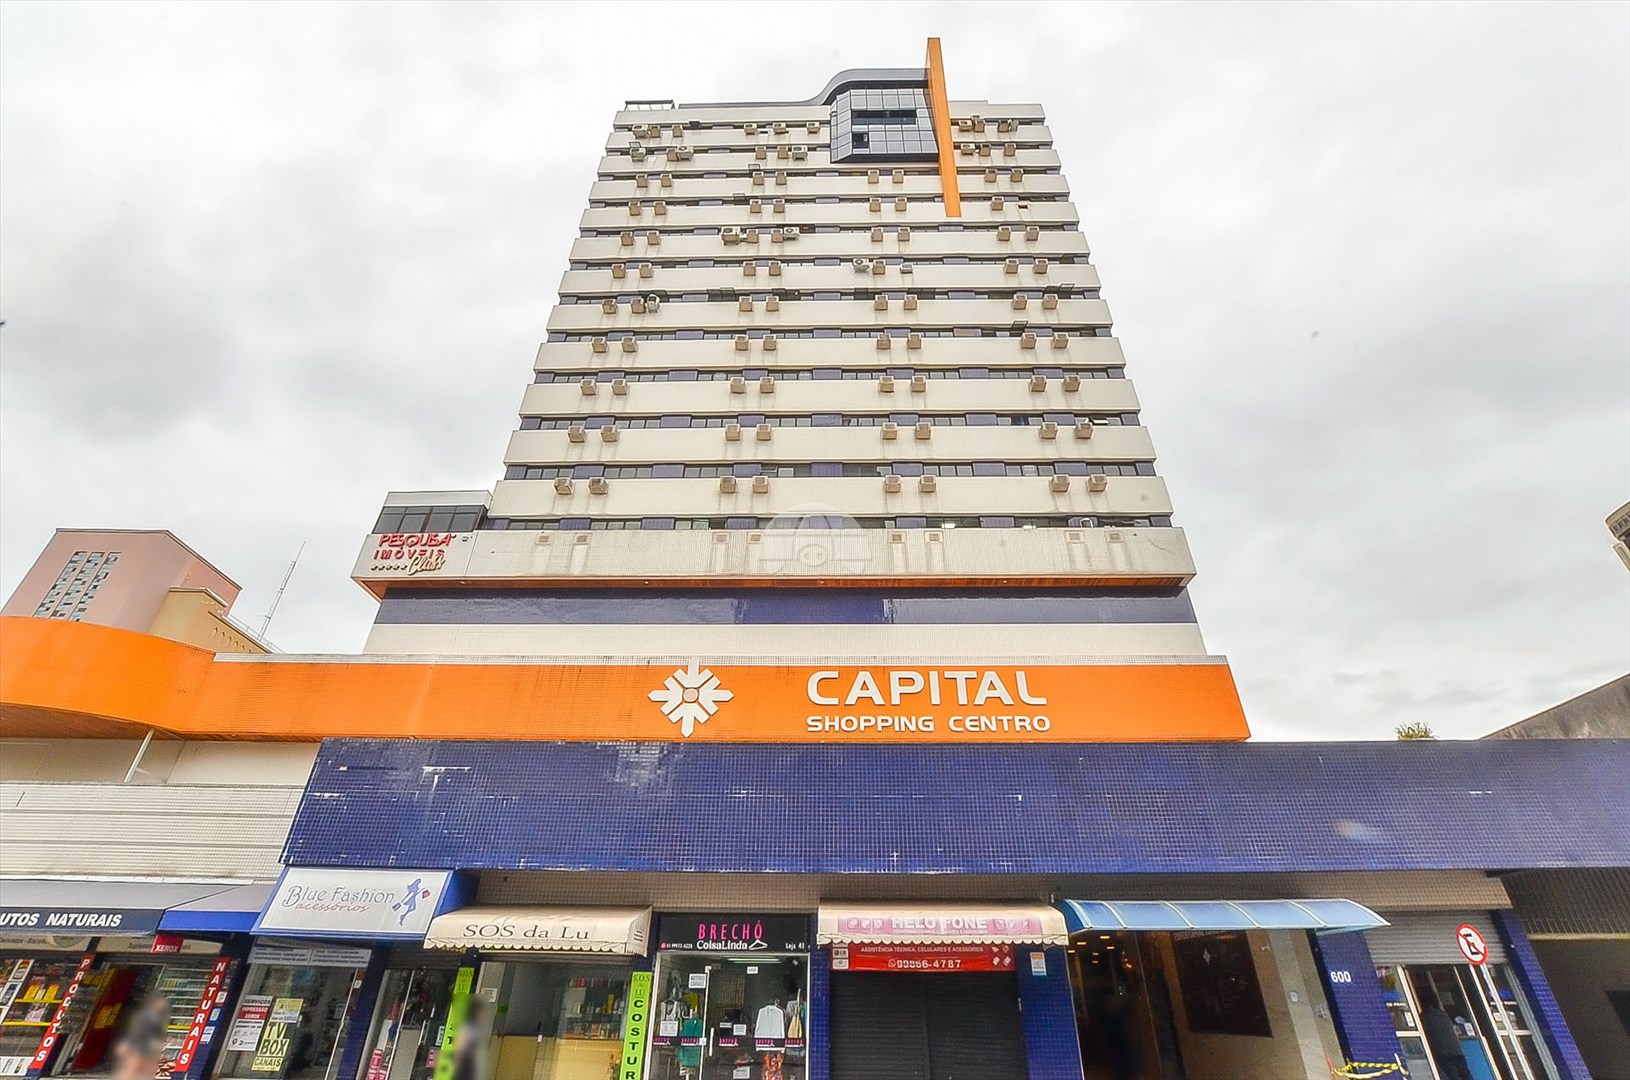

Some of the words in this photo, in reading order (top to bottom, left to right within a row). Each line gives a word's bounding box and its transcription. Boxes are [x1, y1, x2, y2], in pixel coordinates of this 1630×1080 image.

[806, 670, 1048, 706] CAPITAL
[806, 715, 935, 733] SHOPPING
[948, 715, 1052, 733] CENTRO
[282, 886, 327, 907] Blue
[331, 887, 396, 904] Fashion
[295, 902, 370, 912] acessórios
[45, 913, 122, 927] NATURAIS
[941, 917, 988, 929] FONE
[463, 924, 516, 938] SOS
[523, 924, 549, 938] da
[560, 926, 589, 940] Lu
[698, 920, 763, 940] BRECHÓ
[155, 944, 180, 953] XEROX
[1330, 971, 1352, 983] 600
[36, 958, 90, 1062] PRODUTOS
[179, 962, 226, 1065] NATURAIS
[268, 1023, 287, 1039] TV
[259, 1039, 287, 1055] BOX
[254, 1058, 281, 1067] CANAIS
